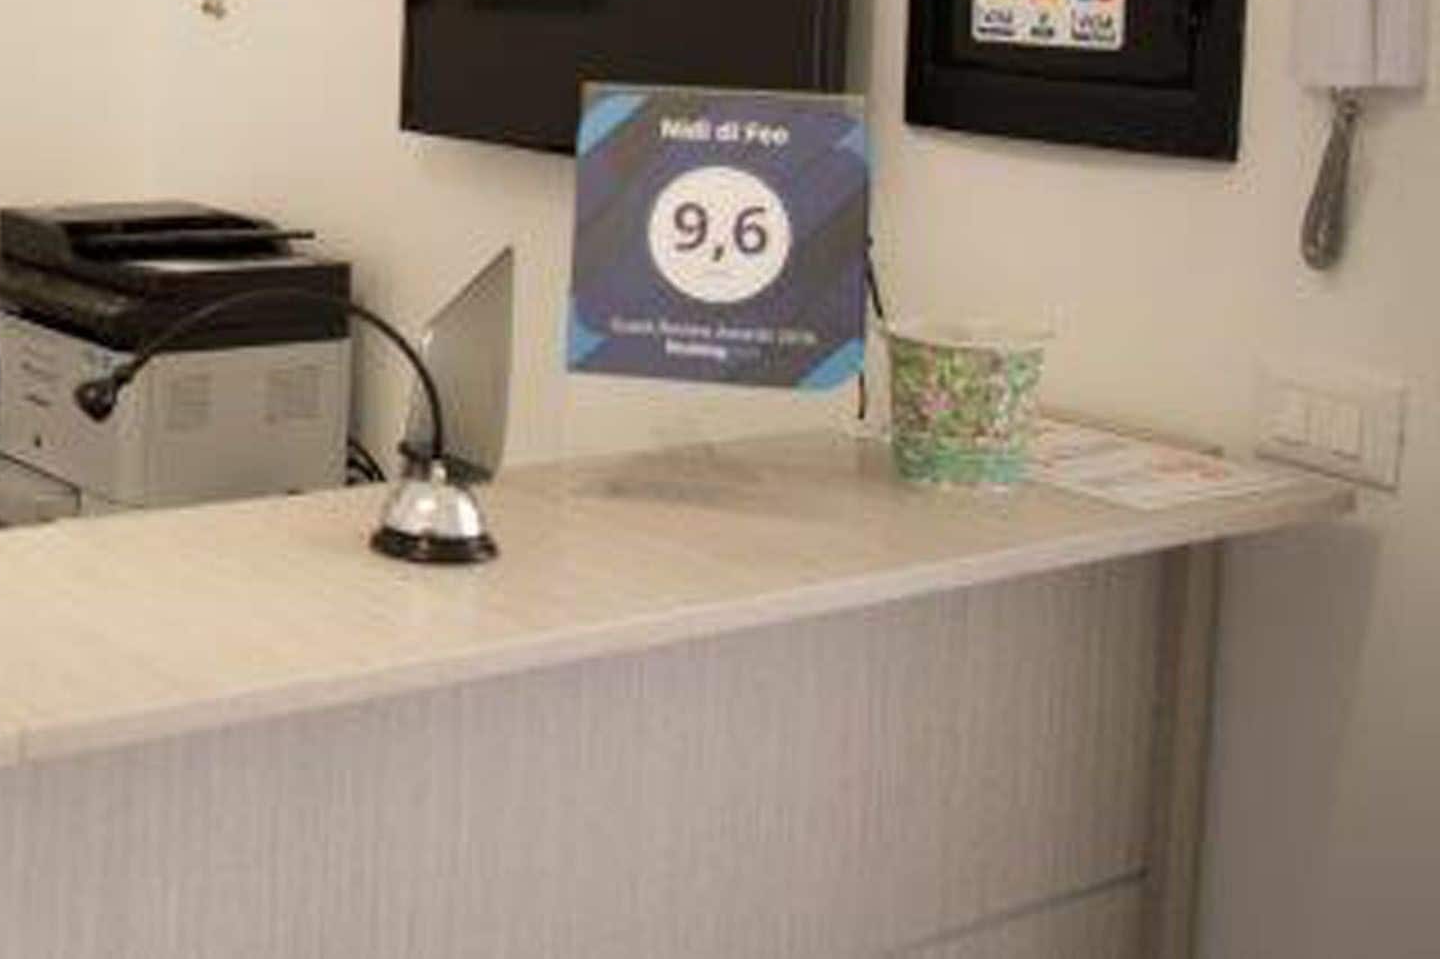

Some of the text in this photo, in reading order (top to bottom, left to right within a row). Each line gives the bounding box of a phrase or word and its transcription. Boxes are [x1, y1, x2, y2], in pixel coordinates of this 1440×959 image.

[661, 117, 711, 141] Nidi
[716, 120, 739, 142] di
[673, 202, 768, 262] 9,6
